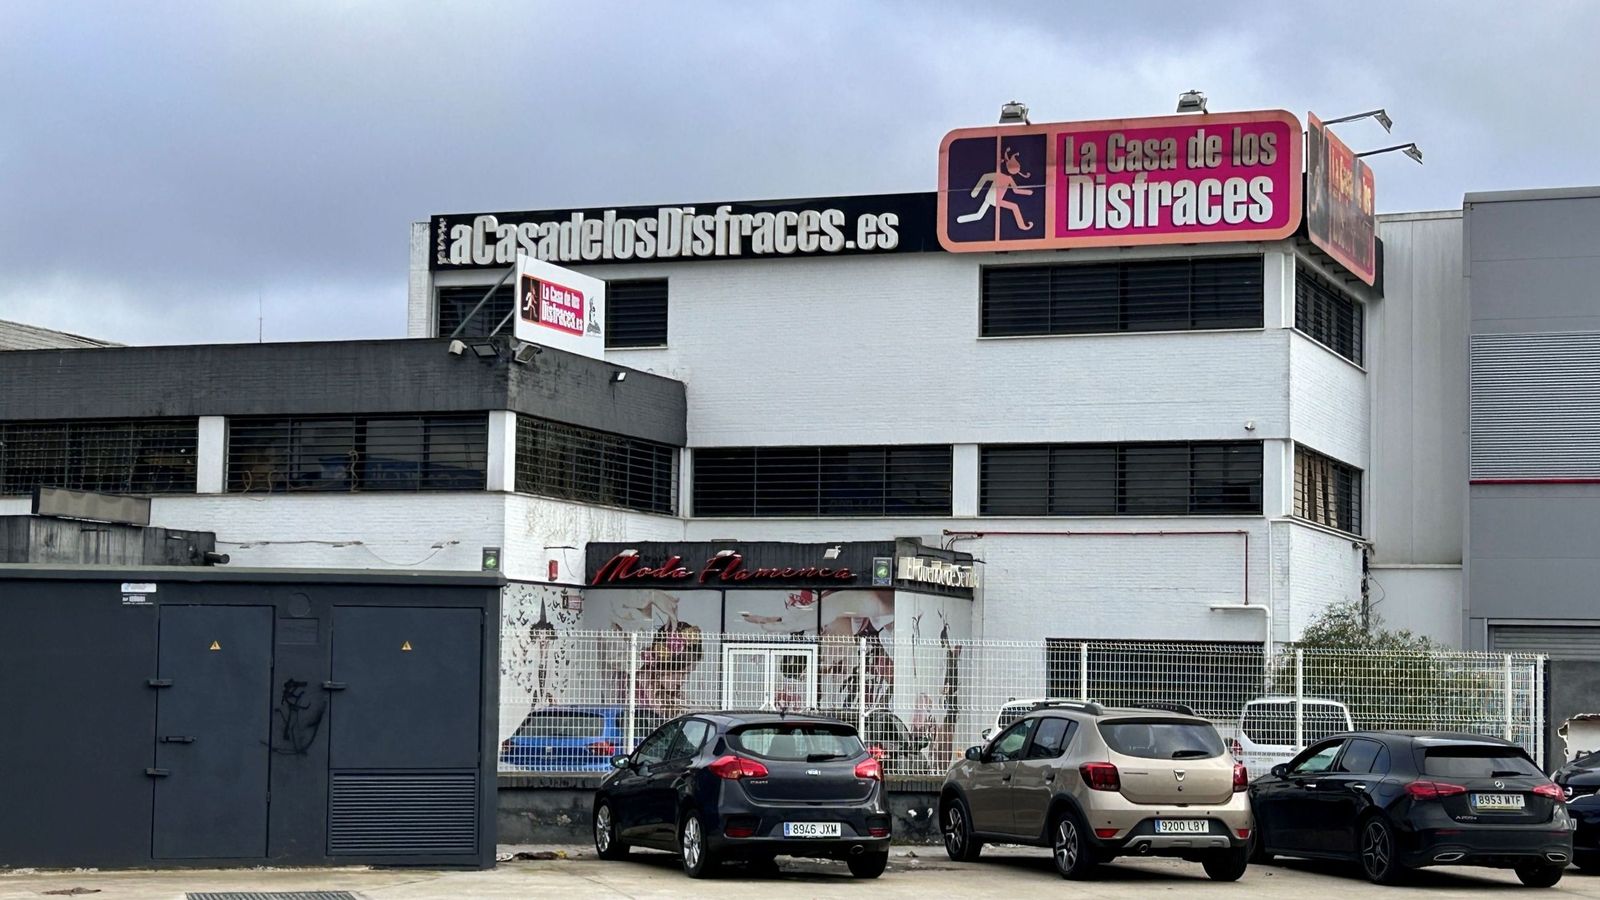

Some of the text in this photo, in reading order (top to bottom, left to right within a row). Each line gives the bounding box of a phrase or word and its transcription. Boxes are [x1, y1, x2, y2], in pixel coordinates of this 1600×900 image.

[1065, 127, 1278, 175] La Casa de los
[1068, 172, 1274, 231] Disfraces
[592, 549, 857, 585] Moda Flamenca
[1478, 794, 1521, 806] 8953 MTF
[793, 823, 837, 835] 8946 JXM
[1161, 821, 1205, 831] 9200 LBY
